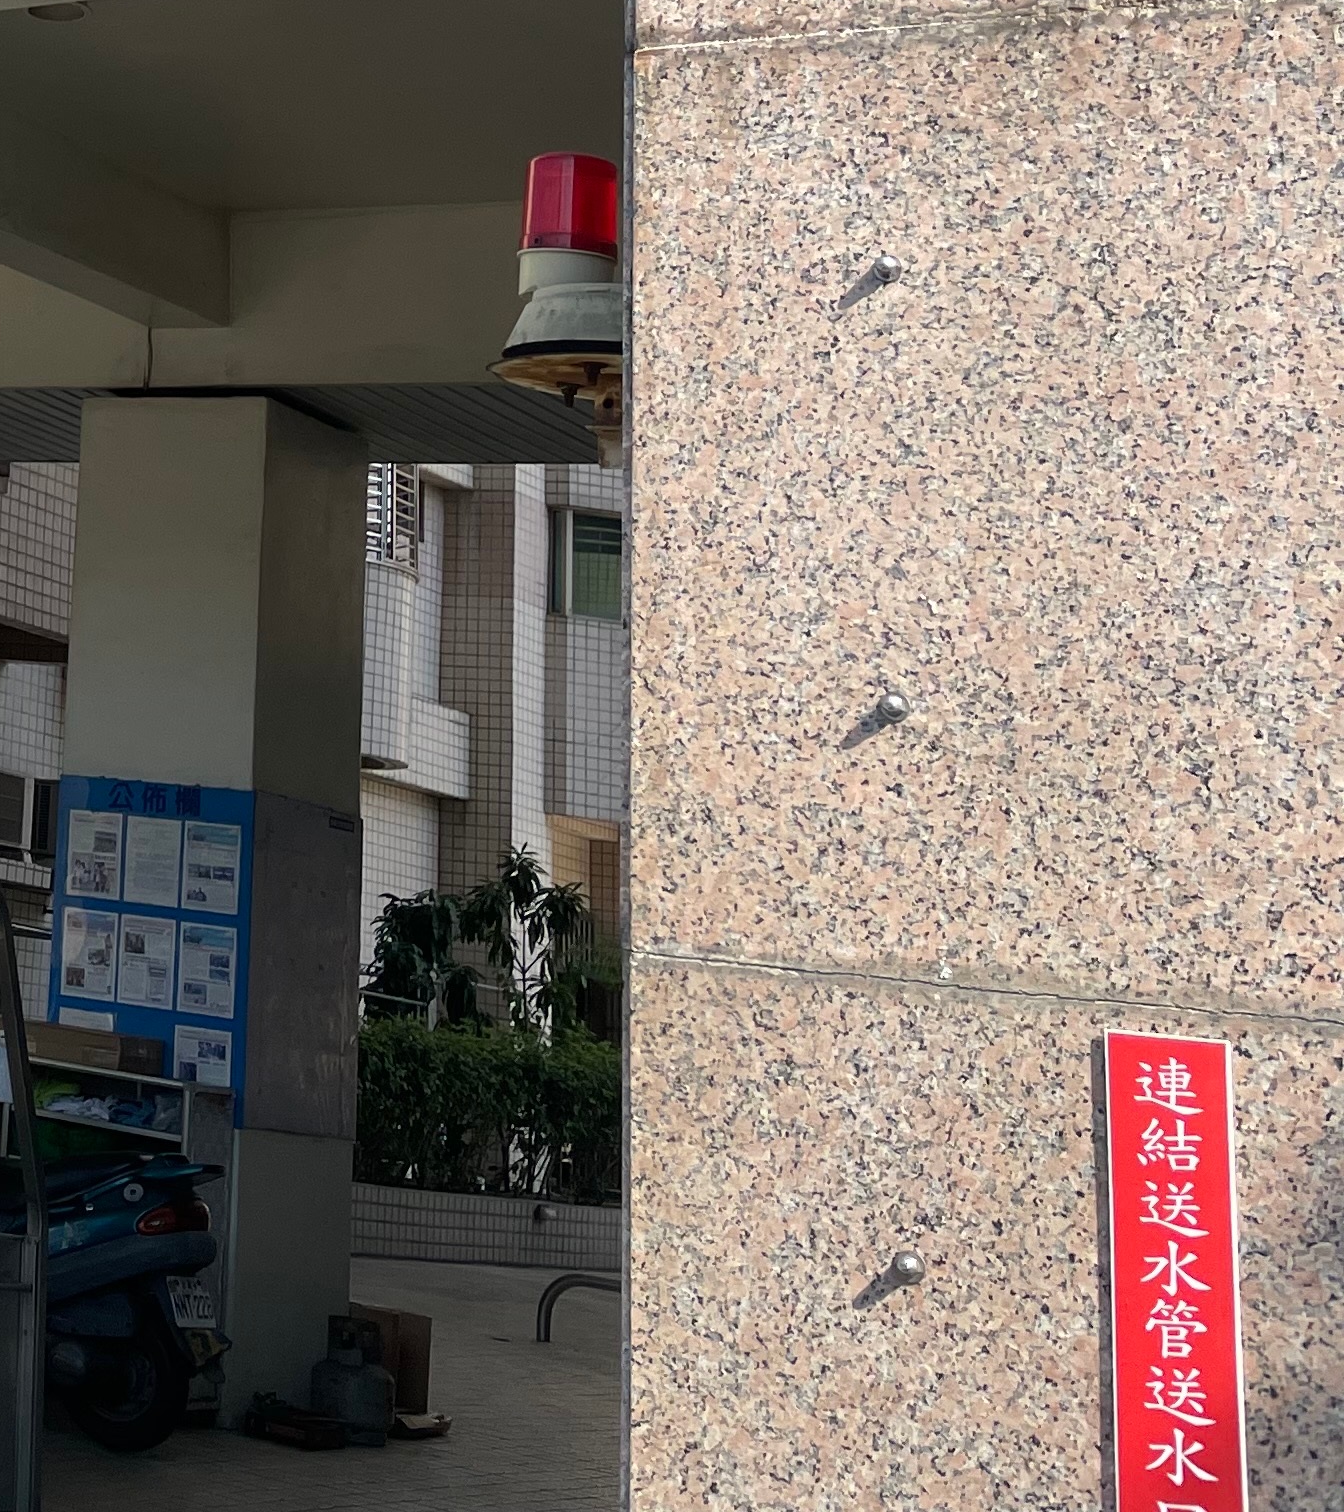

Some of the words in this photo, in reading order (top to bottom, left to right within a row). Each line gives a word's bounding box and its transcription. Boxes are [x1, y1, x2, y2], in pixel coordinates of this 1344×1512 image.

[109, 782, 201, 816] 公佈欄
[1133, 1056, 1220, 1512] 連結送水管送水
